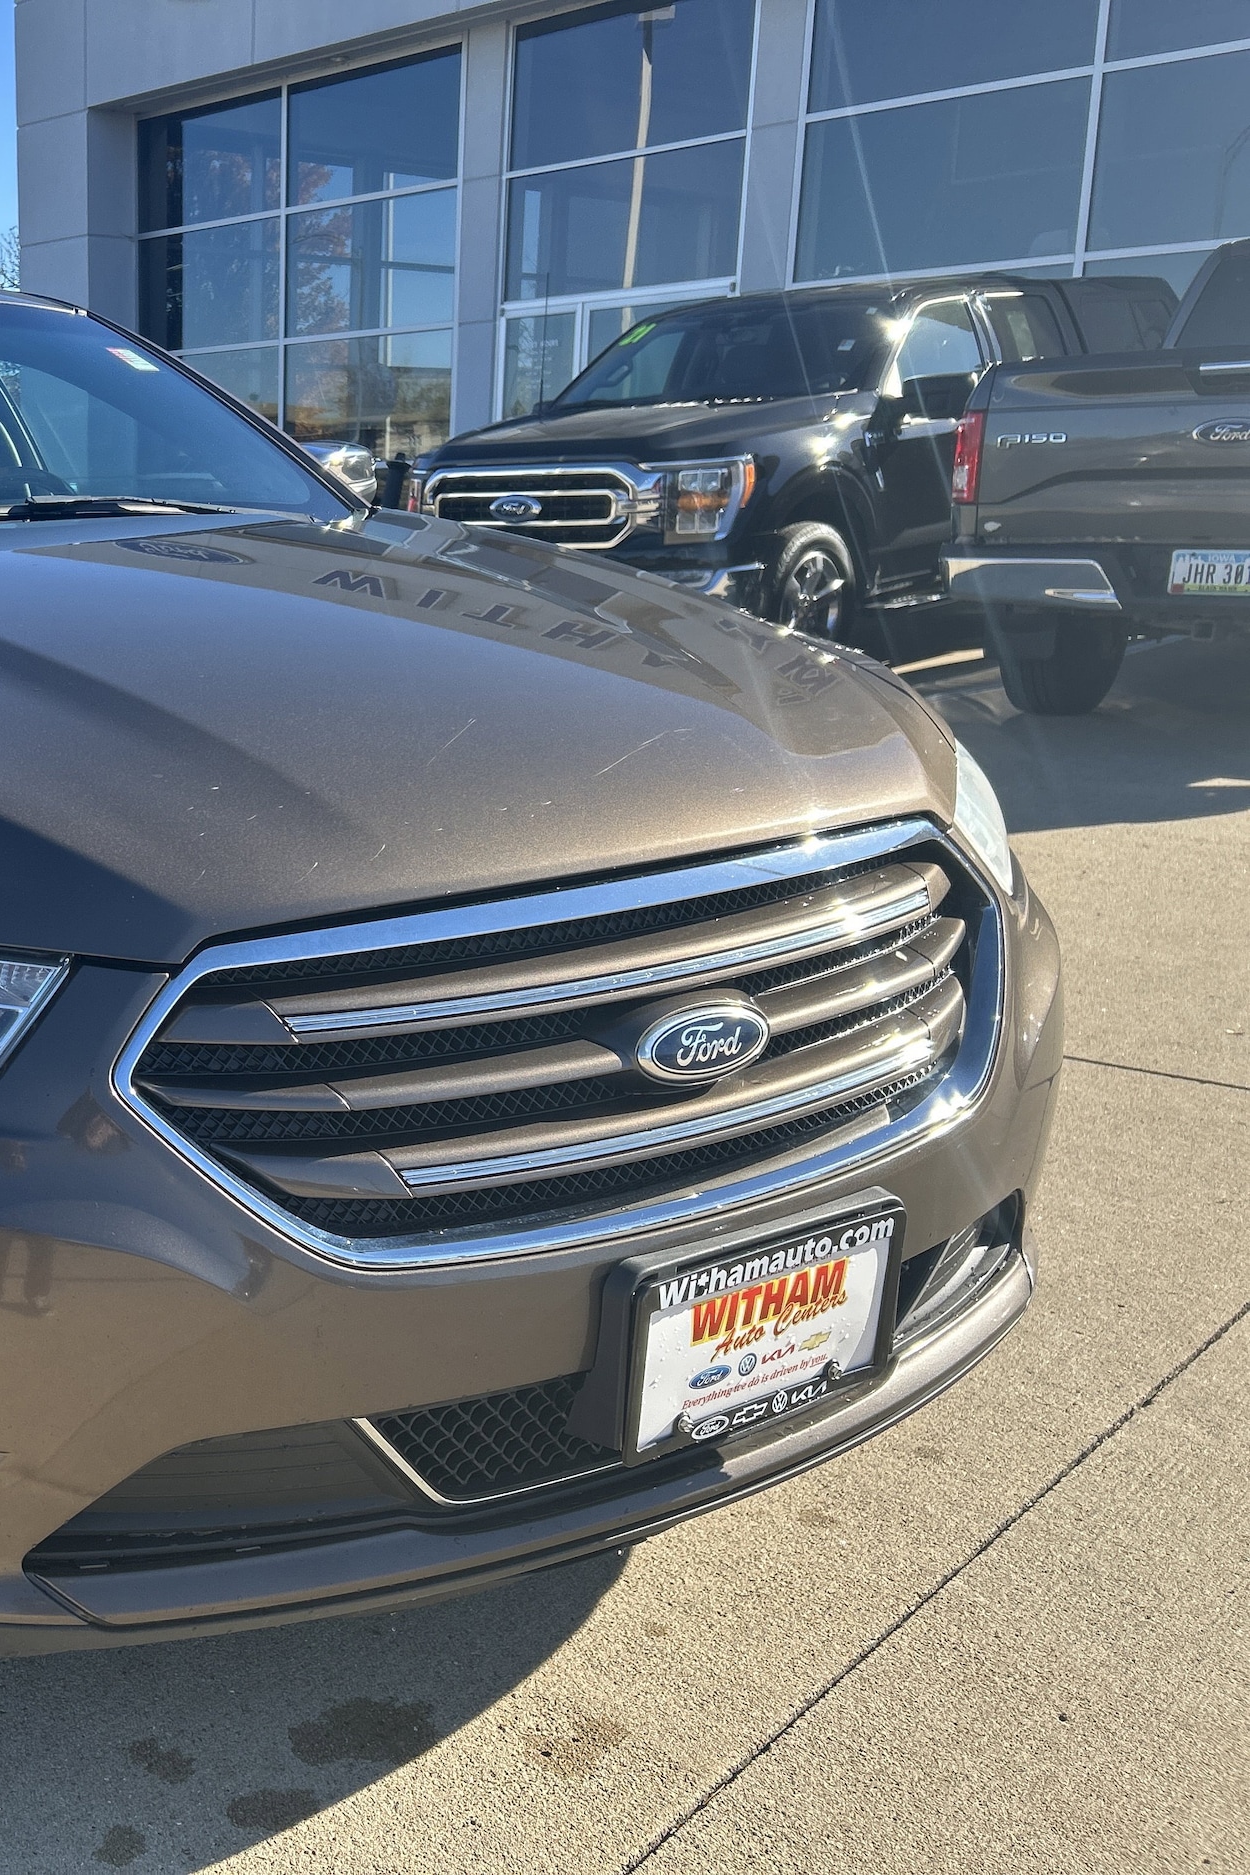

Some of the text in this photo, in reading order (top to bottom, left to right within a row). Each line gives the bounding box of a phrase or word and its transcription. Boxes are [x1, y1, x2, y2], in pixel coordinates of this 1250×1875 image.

[1182, 563, 1217, 584] JHR
[676, 1021, 743, 1067] Ford
[659, 1216, 895, 1310] Withamauto.com
[690, 1257, 849, 1345] WITHAM
[710, 1288, 849, 1363] Auto Centers
[681, 1386, 735, 1410] Everything
[747, 1376, 760, 1387] do
[760, 1372, 769, 1383] is
[769, 1364, 799, 1381] driven
[799, 1358, 810, 1370] by
